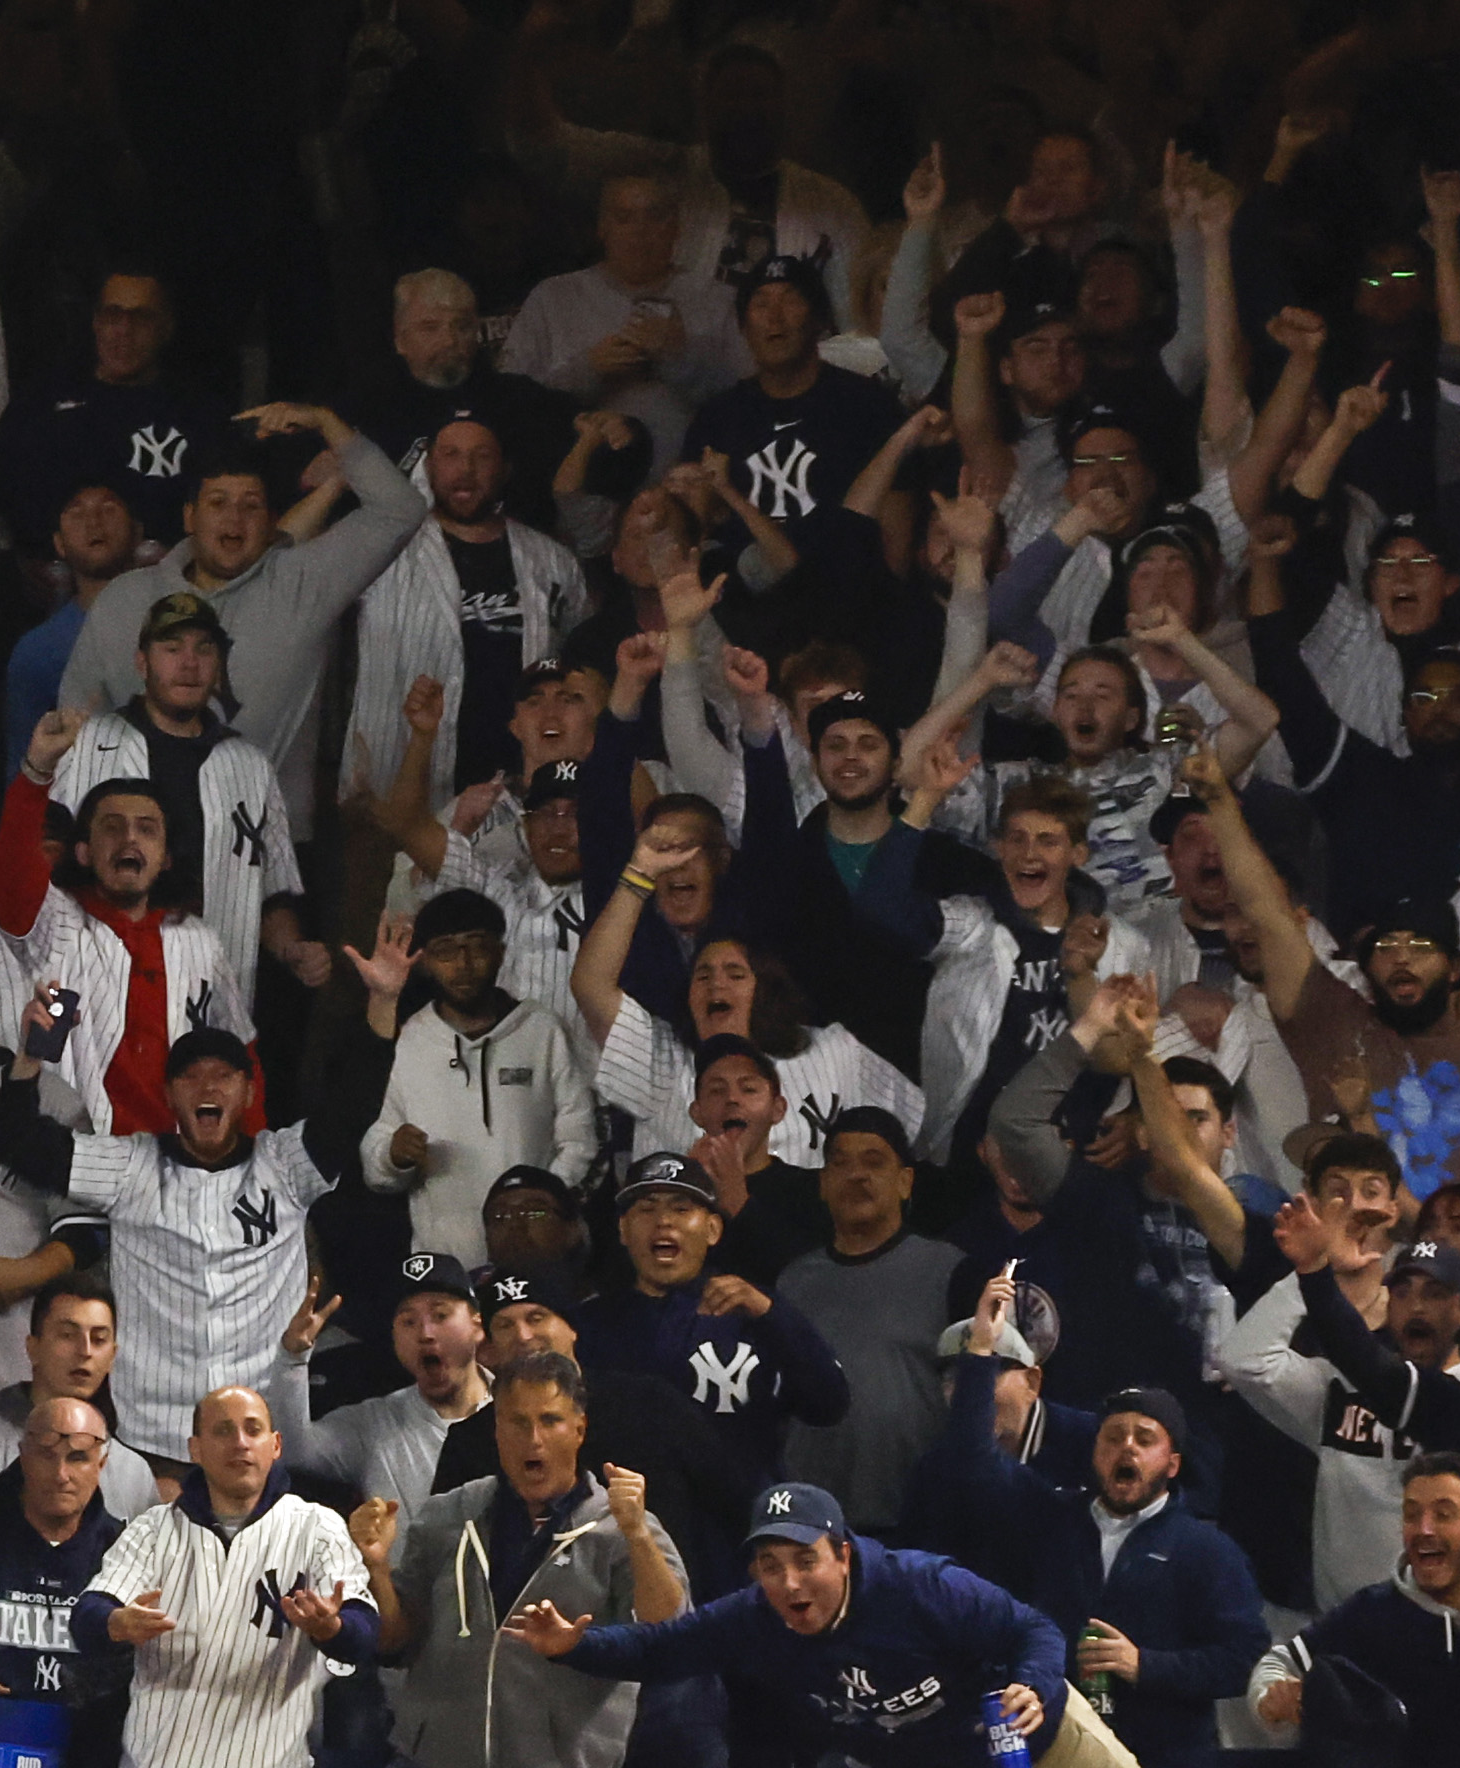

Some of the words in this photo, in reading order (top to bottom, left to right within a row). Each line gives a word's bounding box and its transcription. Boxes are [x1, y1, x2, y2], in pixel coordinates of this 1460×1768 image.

[131, 423, 188, 479] NY
[747, 438, 820, 519] NY
[553, 760, 578, 781] NY
[231, 802, 269, 866] NY
[801, 1091, 842, 1147] NY
[231, 1189, 276, 1248] NY
[1413, 1241, 1438, 1258] NY
[494, 1276, 529, 1301] NY
[690, 1341, 759, 1413] NY
[766, 1490, 792, 1515] NY
[33, 1654, 62, 1692] NY
